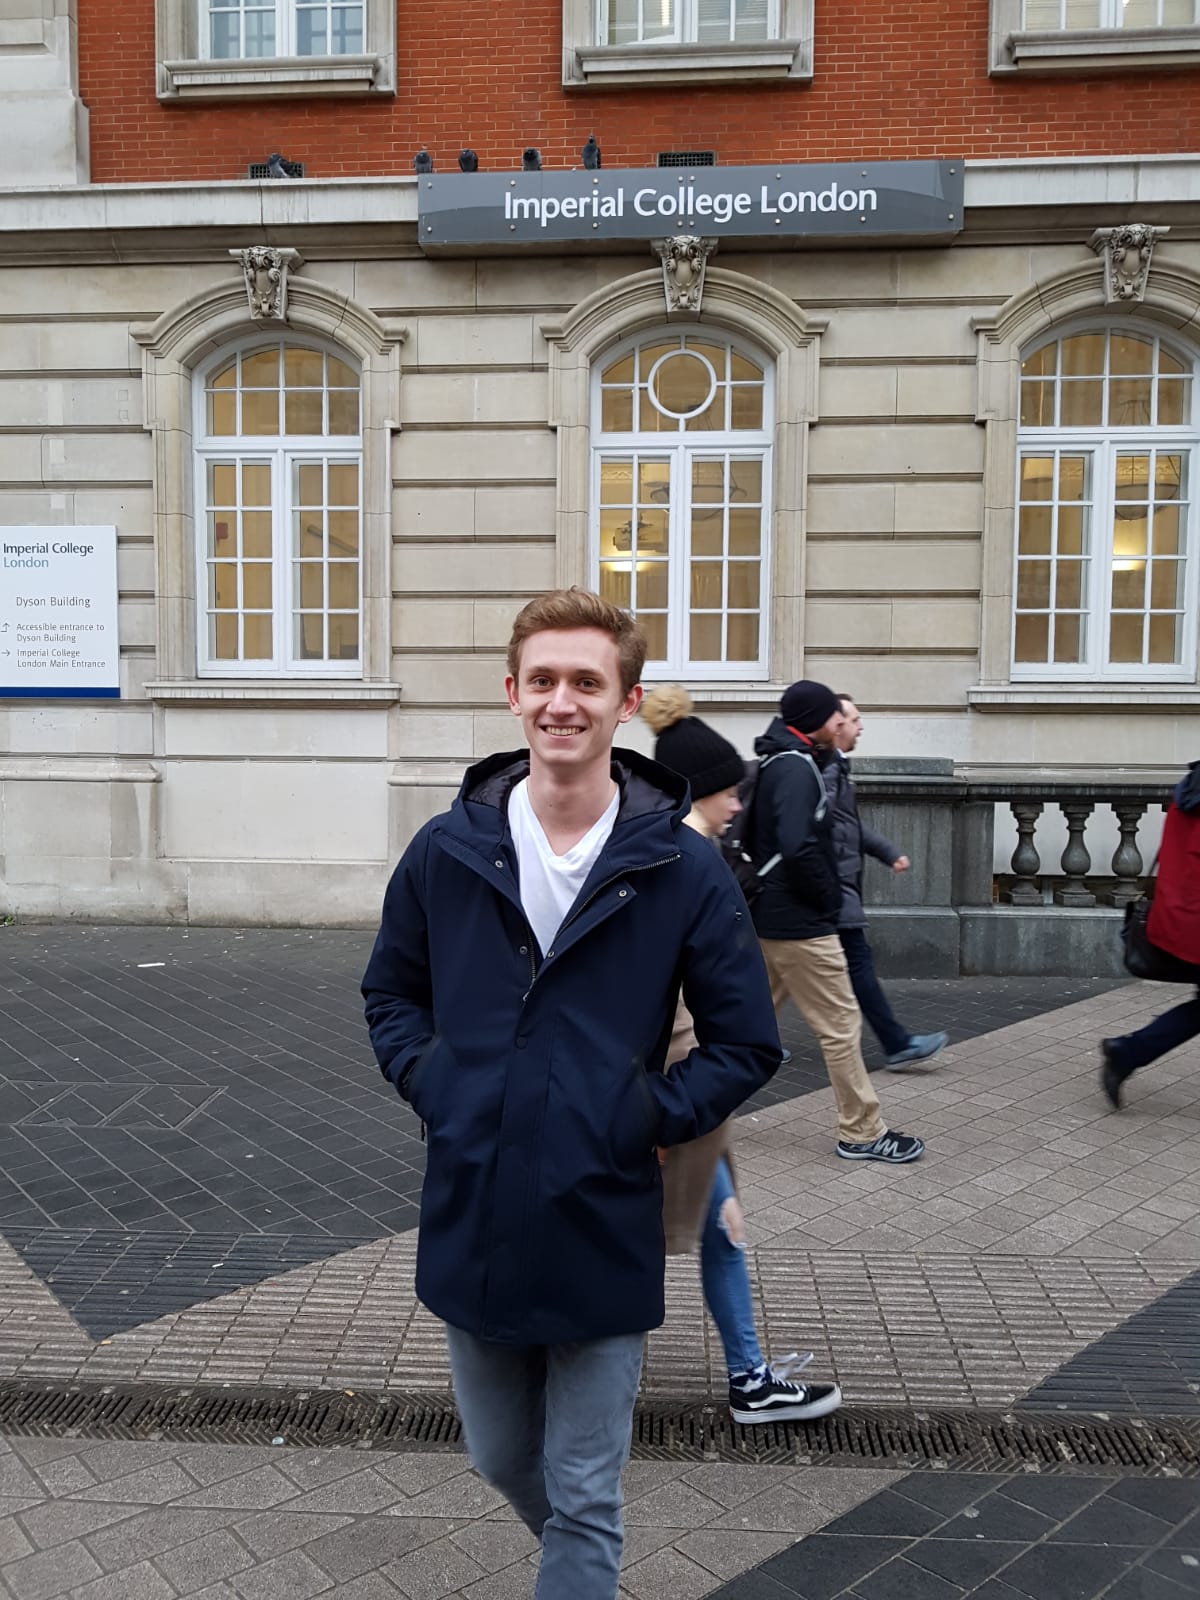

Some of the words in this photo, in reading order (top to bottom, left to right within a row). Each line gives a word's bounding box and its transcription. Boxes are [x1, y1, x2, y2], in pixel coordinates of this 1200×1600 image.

[504, 187, 624, 227] Imperial
[633, 186, 752, 223] College
[761, 182, 877, 213] London
[3, 543, 49, 556] Imperial
[52, 543, 94, 557] College
[3, 557, 49, 568] London
[16, 596, 46, 608] Dyson
[50, 596, 91, 608] Building
[16, 623, 57, 632] Accessible
[59, 623, 94, 632] entrance
[96, 623, 105, 631] to
[16, 634, 41, 643] Dyson
[43, 634, 77, 644] Building
[17, 649, 49, 658] Imperial
[51, 649, 81, 659] College
[17, 660, 47, 668] London
[49, 660, 69, 668] Main
[71, 660, 106, 668] Entrance
